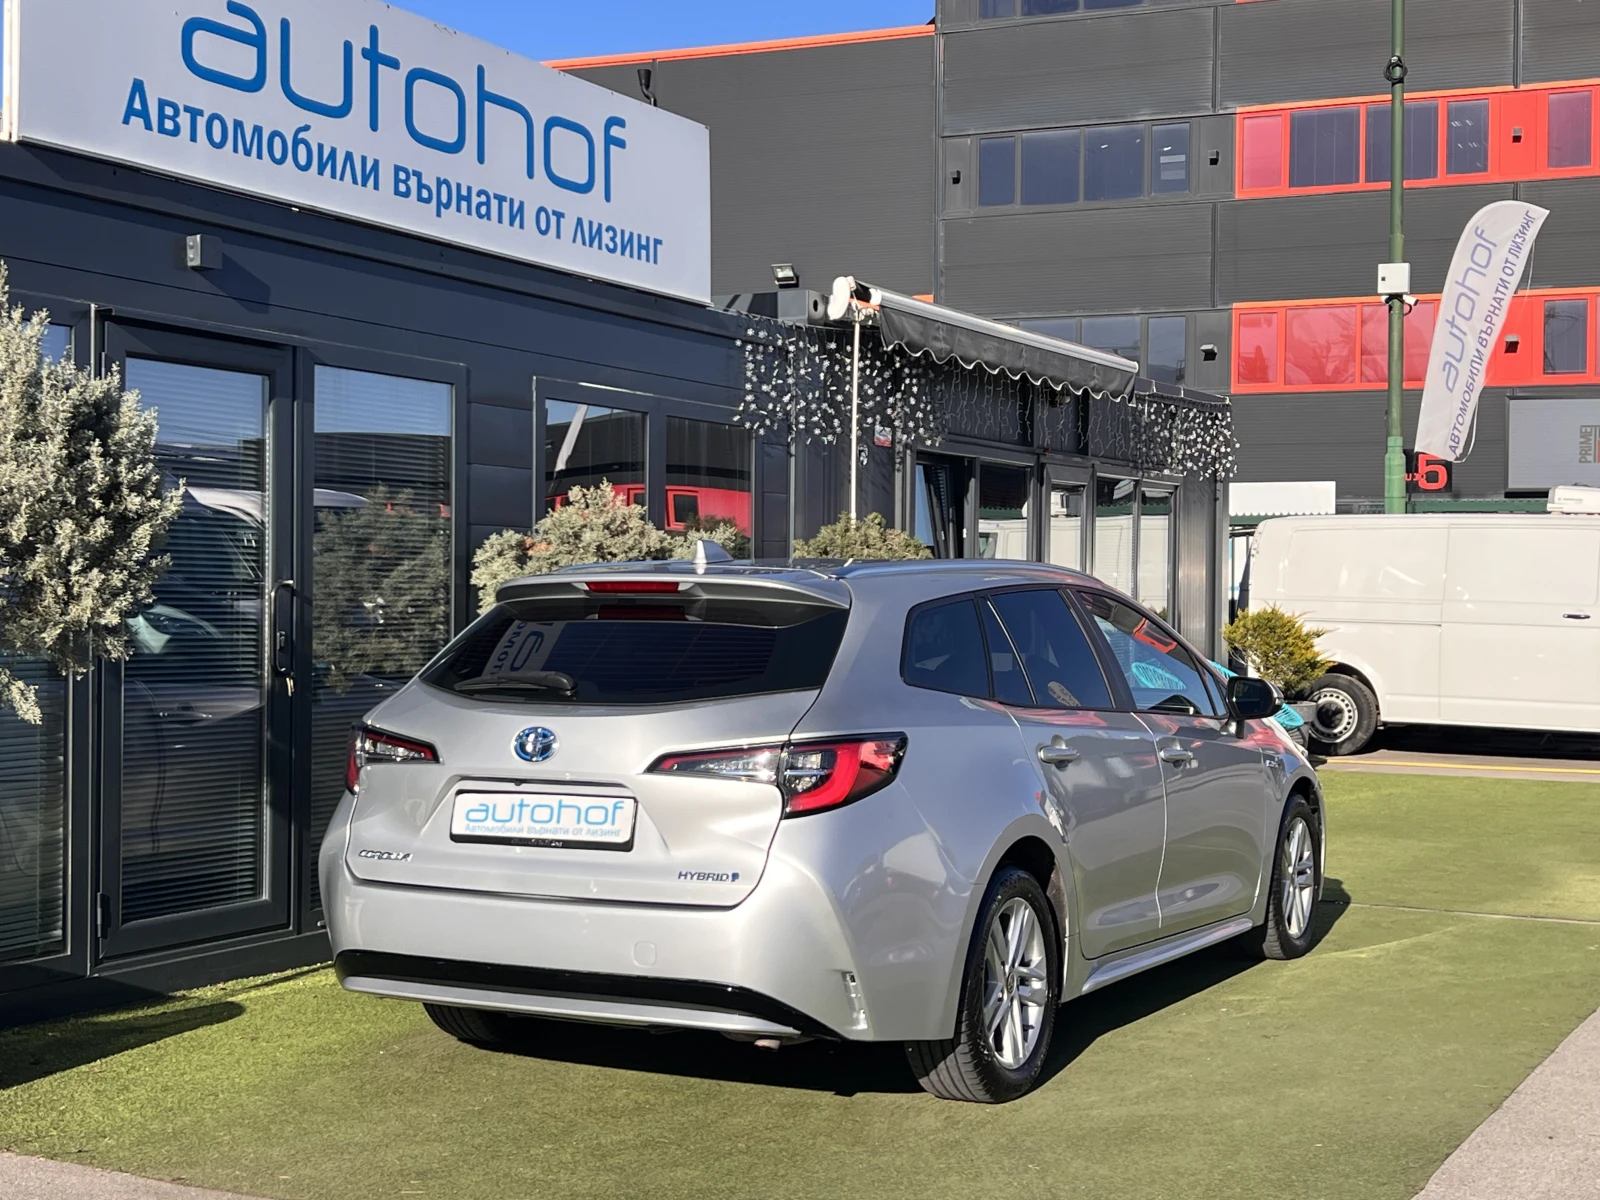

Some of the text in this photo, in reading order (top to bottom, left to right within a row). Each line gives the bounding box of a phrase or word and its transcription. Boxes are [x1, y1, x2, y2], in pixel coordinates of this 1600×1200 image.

[181, 0, 627, 203] autohof
[122, 78, 664, 265] Автомобили върнати от лизинг
[1441, 225, 1498, 394] autohof
[1448, 210, 1536, 458] АВТОМОБИЛИ ВЪРНАТИ ОТ ЛИЗИНГ
[1579, 426, 1592, 464] PRIME
[1418, 453, 1448, 490] 5
[464, 824, 621, 838] Автомобили върнати от лизинг
[465, 798, 625, 826] autohof
[677, 870, 730, 882] HYBRID
